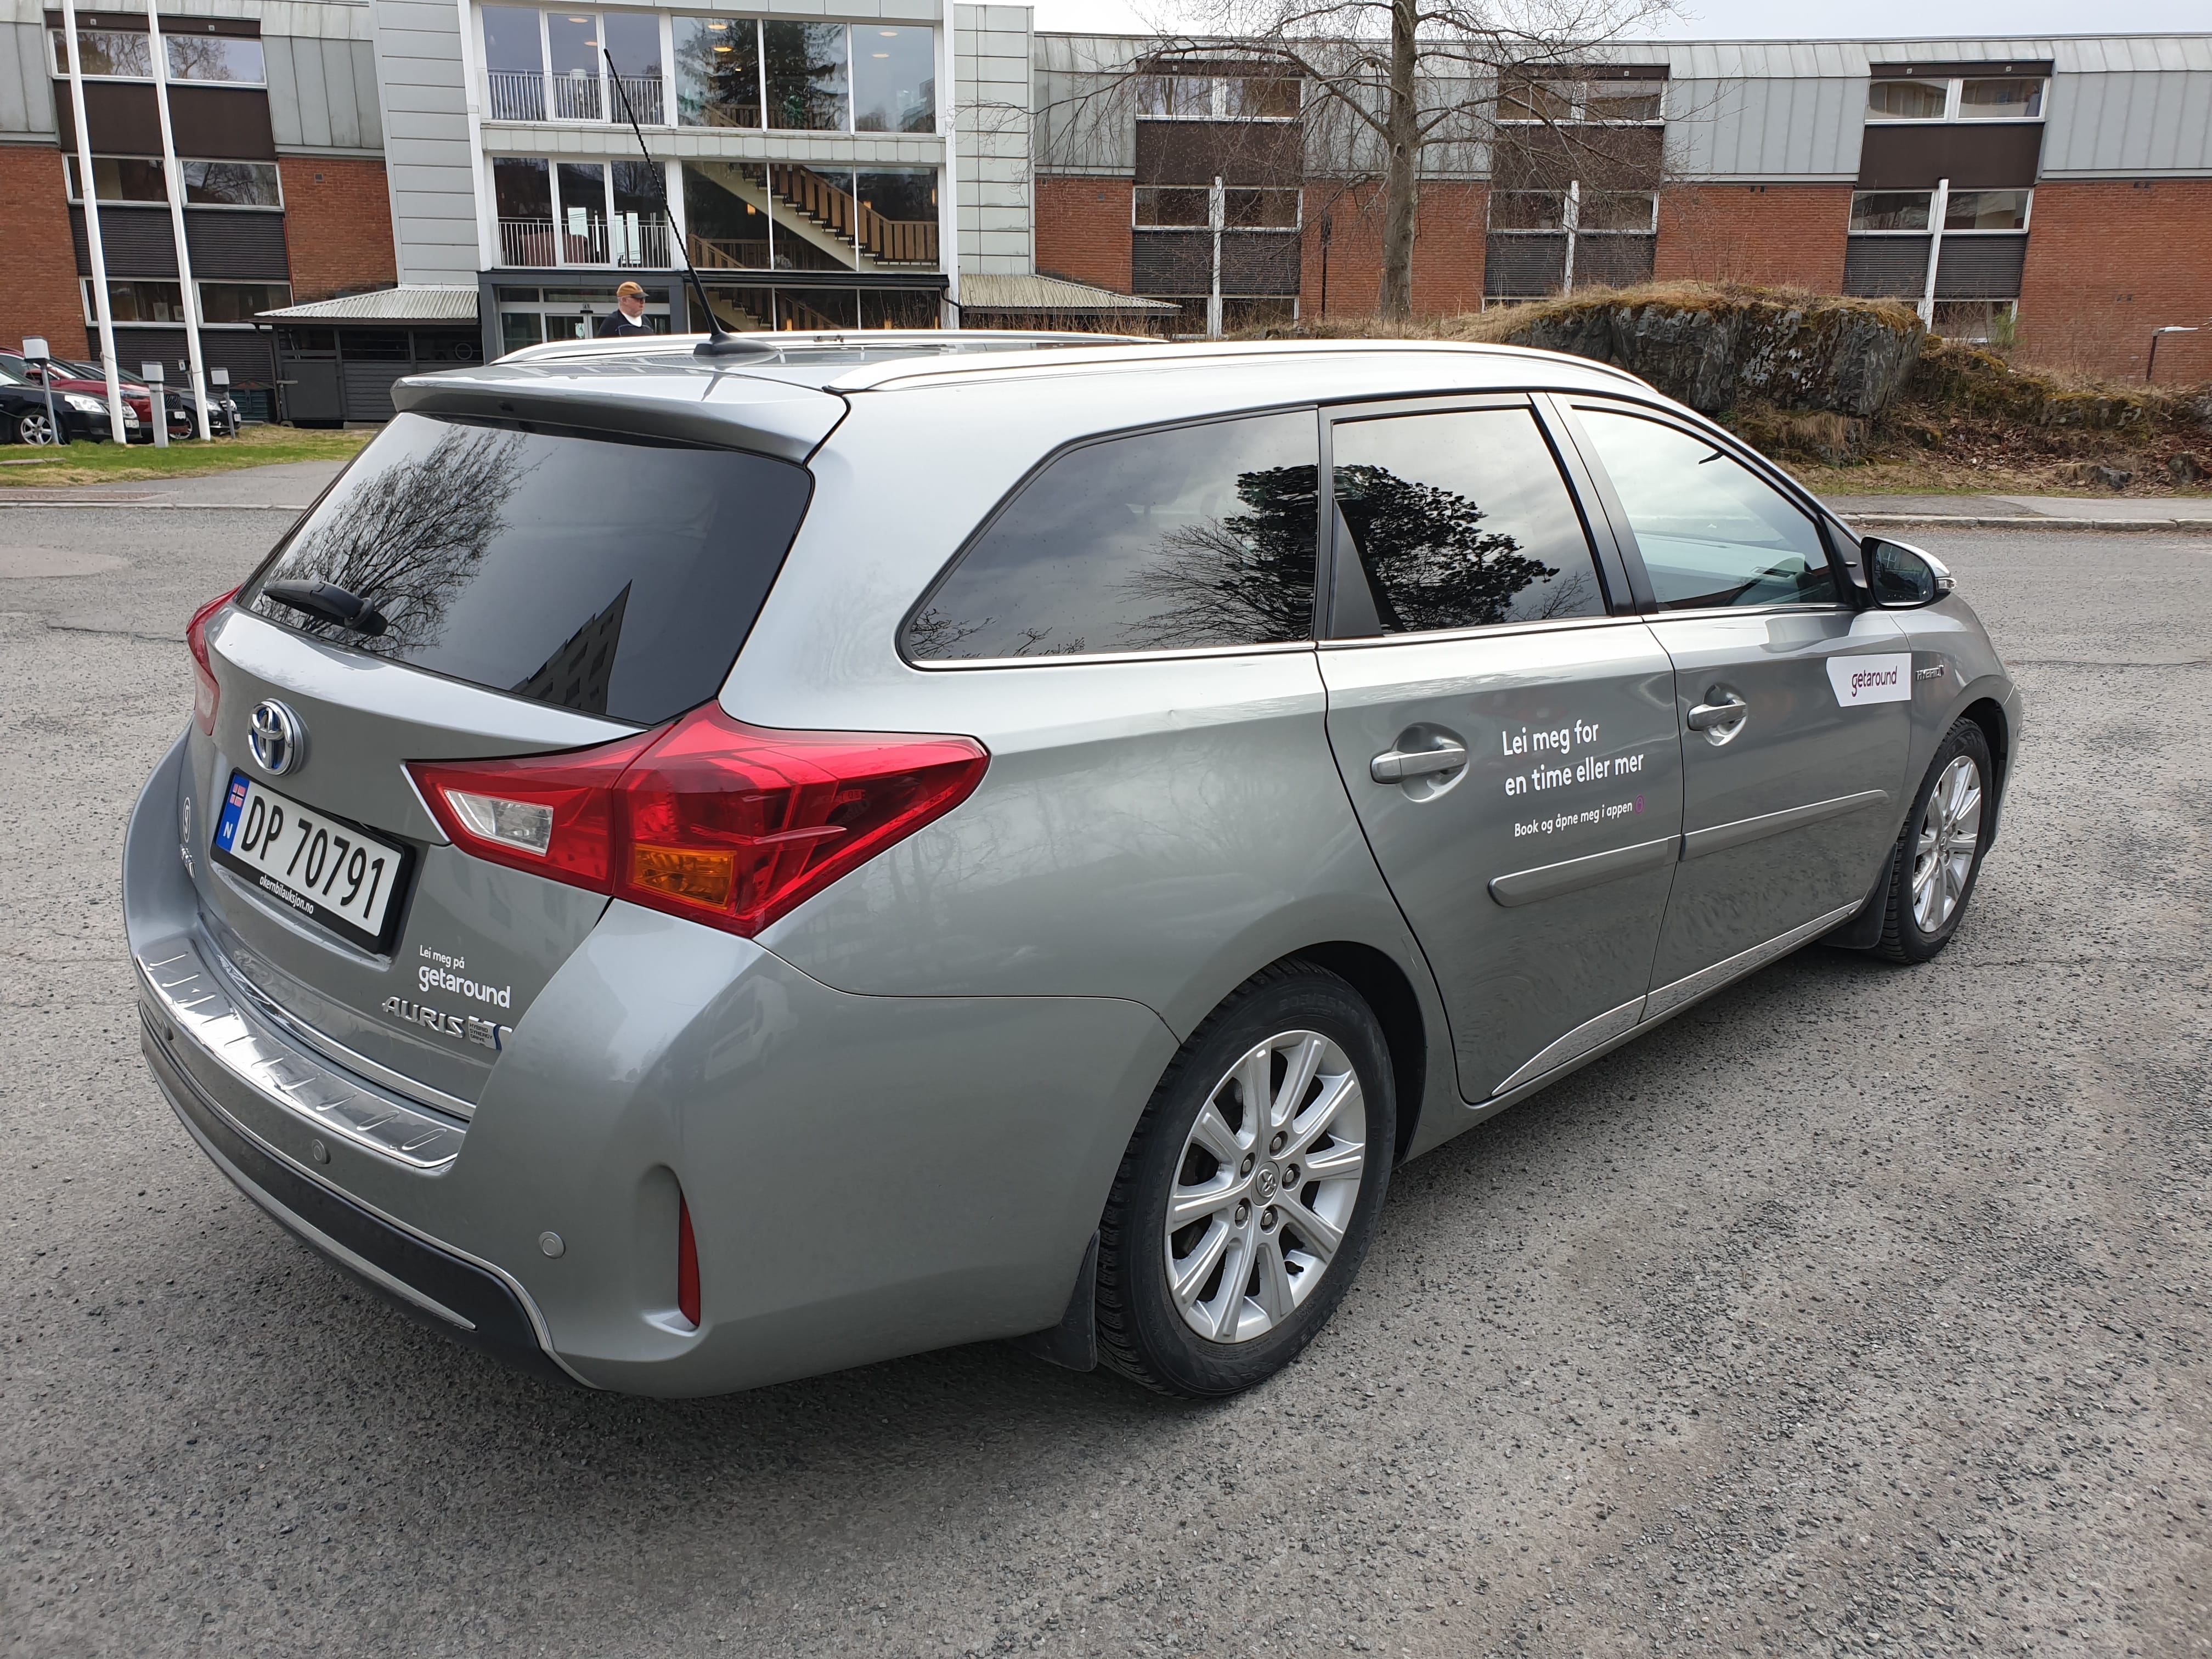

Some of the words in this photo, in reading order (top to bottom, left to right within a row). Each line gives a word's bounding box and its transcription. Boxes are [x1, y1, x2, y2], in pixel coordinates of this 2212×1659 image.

[1851, 666, 1897, 697] getaround
[1502, 727, 1527, 756] Lei
[1533, 729, 1570, 754] meg
[1574, 720, 1599, 744] for
[1505, 775, 1527, 796] en
[1531, 764, 1572, 791] time
[1576, 756, 1610, 782] eller
[1615, 754, 1644, 775] mer
[223, 821, 233, 839] N
[1514, 820, 1539, 837] Book
[1541, 819, 1553, 834] og
[1555, 814, 1578, 831] åpne
[1580, 809, 1599, 823] meg
[1601, 804, 1605, 817] i
[1606, 801, 1633, 820] appen
[241, 795, 284, 860] DP
[286, 817, 385, 919] 70791
[259, 874, 313, 915] okernbilauksjon.no
[420, 945, 432, 958] Lei
[433, 951, 451, 968] meg
[453, 956, 465, 969] på
[419, 966, 511, 1008] getaround
[382, 996, 465, 1039] AURIS
[470, 1023, 488, 1033] HYBRID
[470, 1029, 493, 1040] SYNERGY
[470, 1034, 486, 1042] DRIVE
